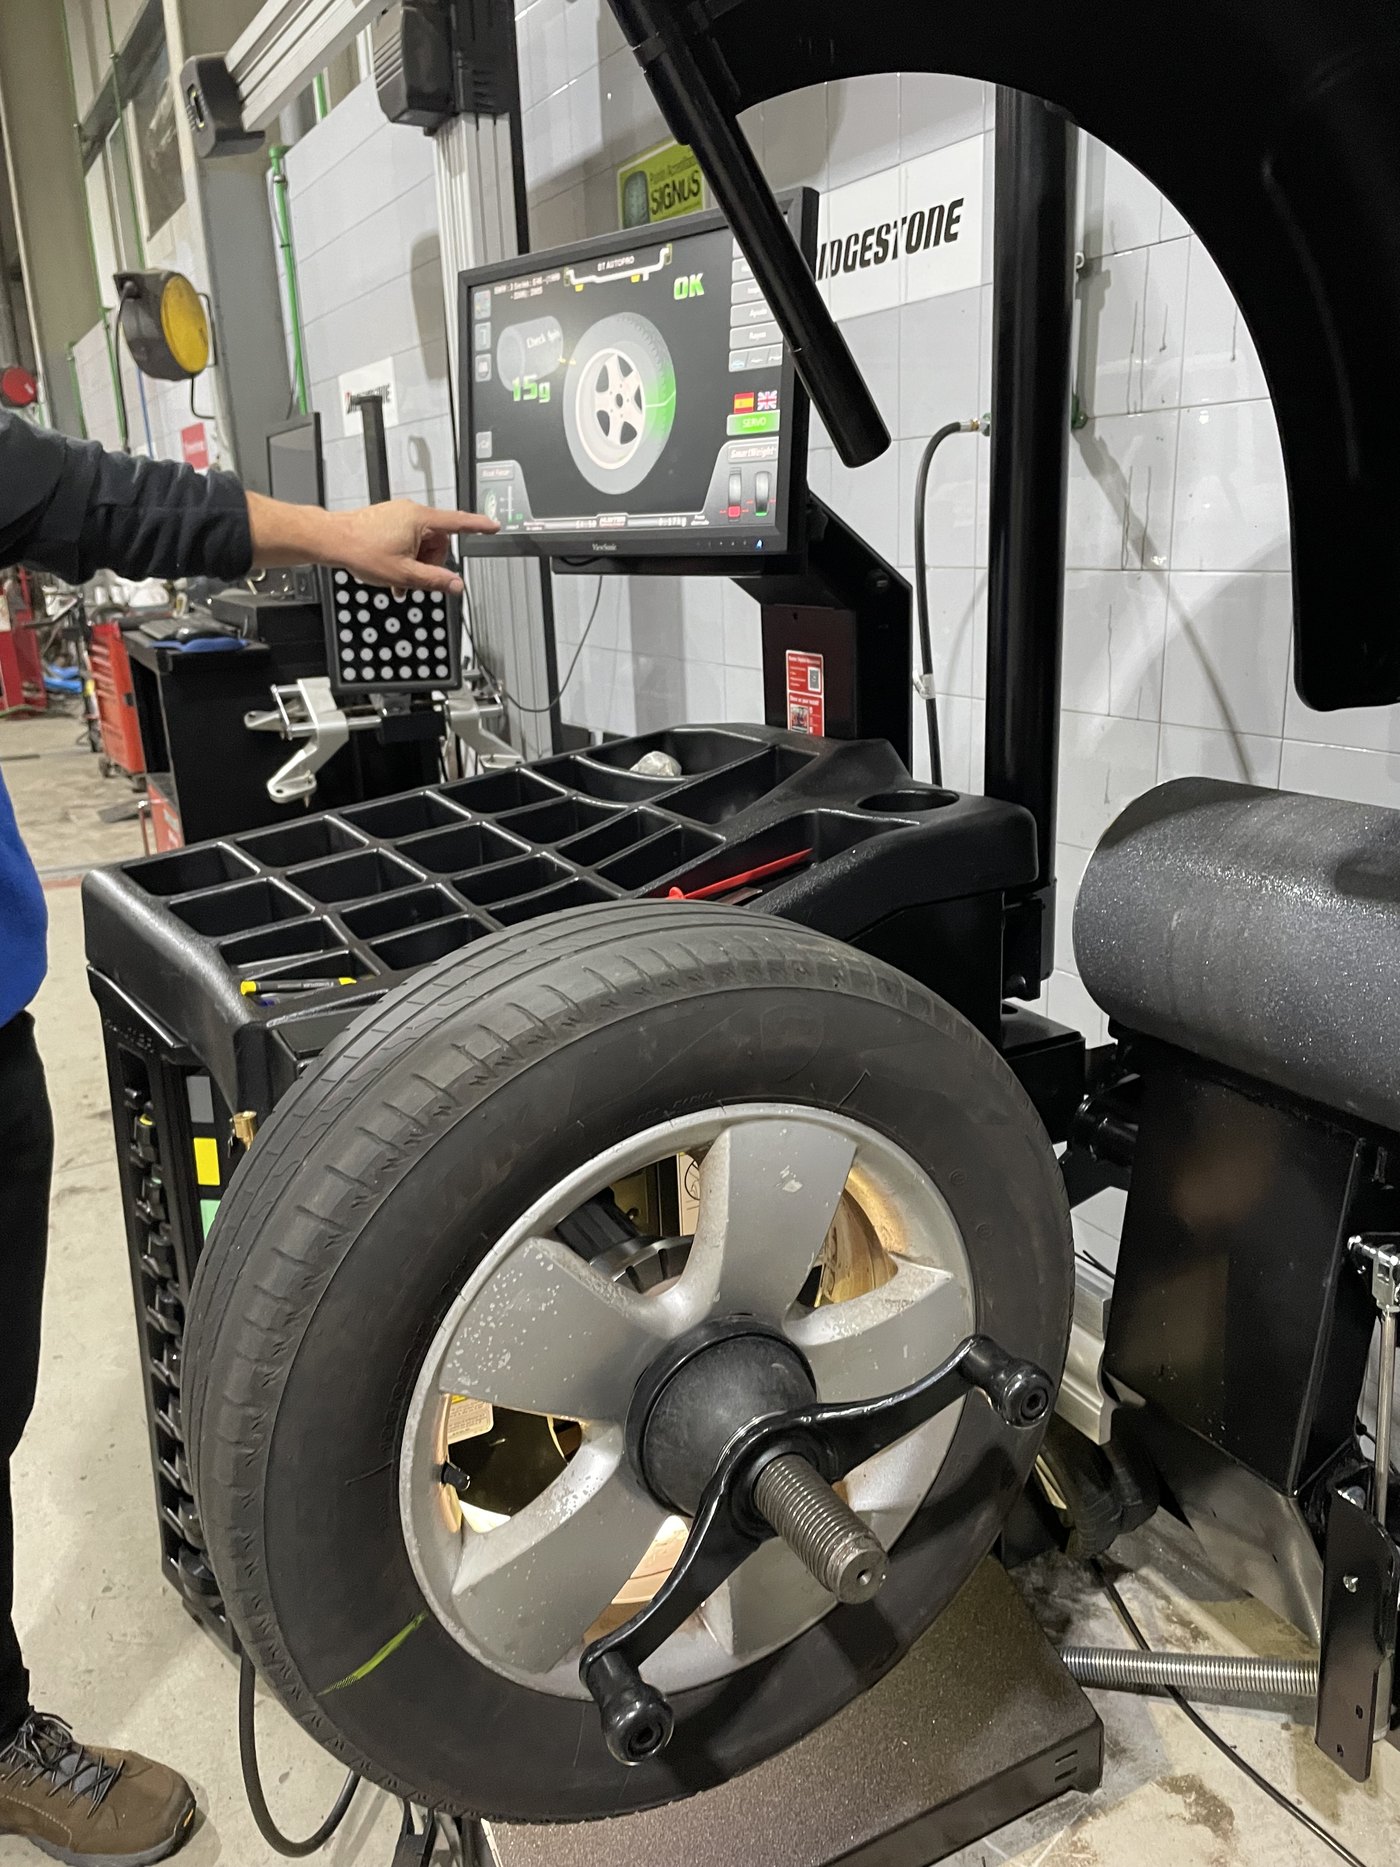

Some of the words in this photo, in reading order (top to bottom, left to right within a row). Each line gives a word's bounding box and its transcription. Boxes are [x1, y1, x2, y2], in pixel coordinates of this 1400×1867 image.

[651, 169, 700, 216] SIGNUS
[817, 198, 964, 281] IDGESTONE
[673, 272, 705, 300] OK
[512, 374, 551, 403] 15g
[742, 416, 767, 428] SERVO
